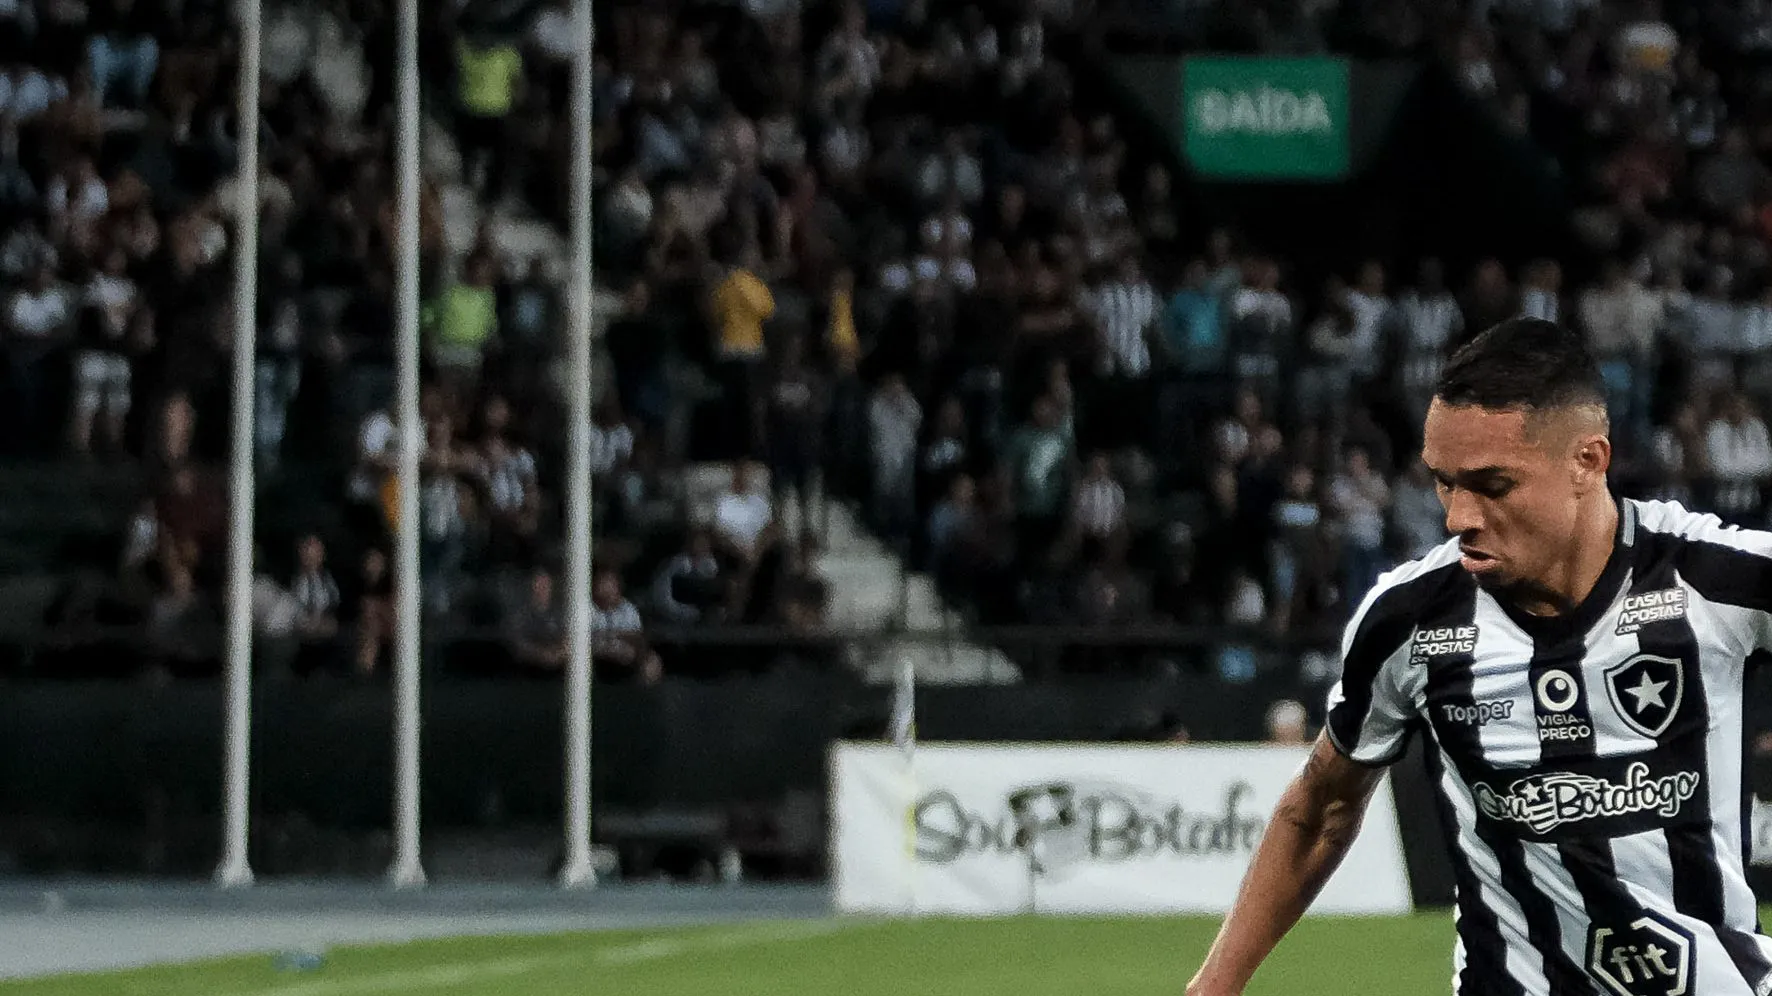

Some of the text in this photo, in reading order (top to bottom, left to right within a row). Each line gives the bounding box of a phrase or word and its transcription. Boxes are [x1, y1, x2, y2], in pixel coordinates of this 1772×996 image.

[1199, 82, 1333, 134] SAÍDA
[1625, 589, 1684, 610] CASA DE
[1618, 603, 1684, 626] APOSTAS
[1416, 626, 1477, 642] CASA DE
[1412, 640, 1474, 656] APOSTAS
[1442, 700, 1513, 726] Topper
[1536, 713, 1580, 726] VIGIA
[1540, 725, 1591, 741] PREÇO
[1547, 762, 1699, 824] Botafogo
[1084, 779, 1265, 859] Botafo
[1609, 943, 1677, 984] fit
